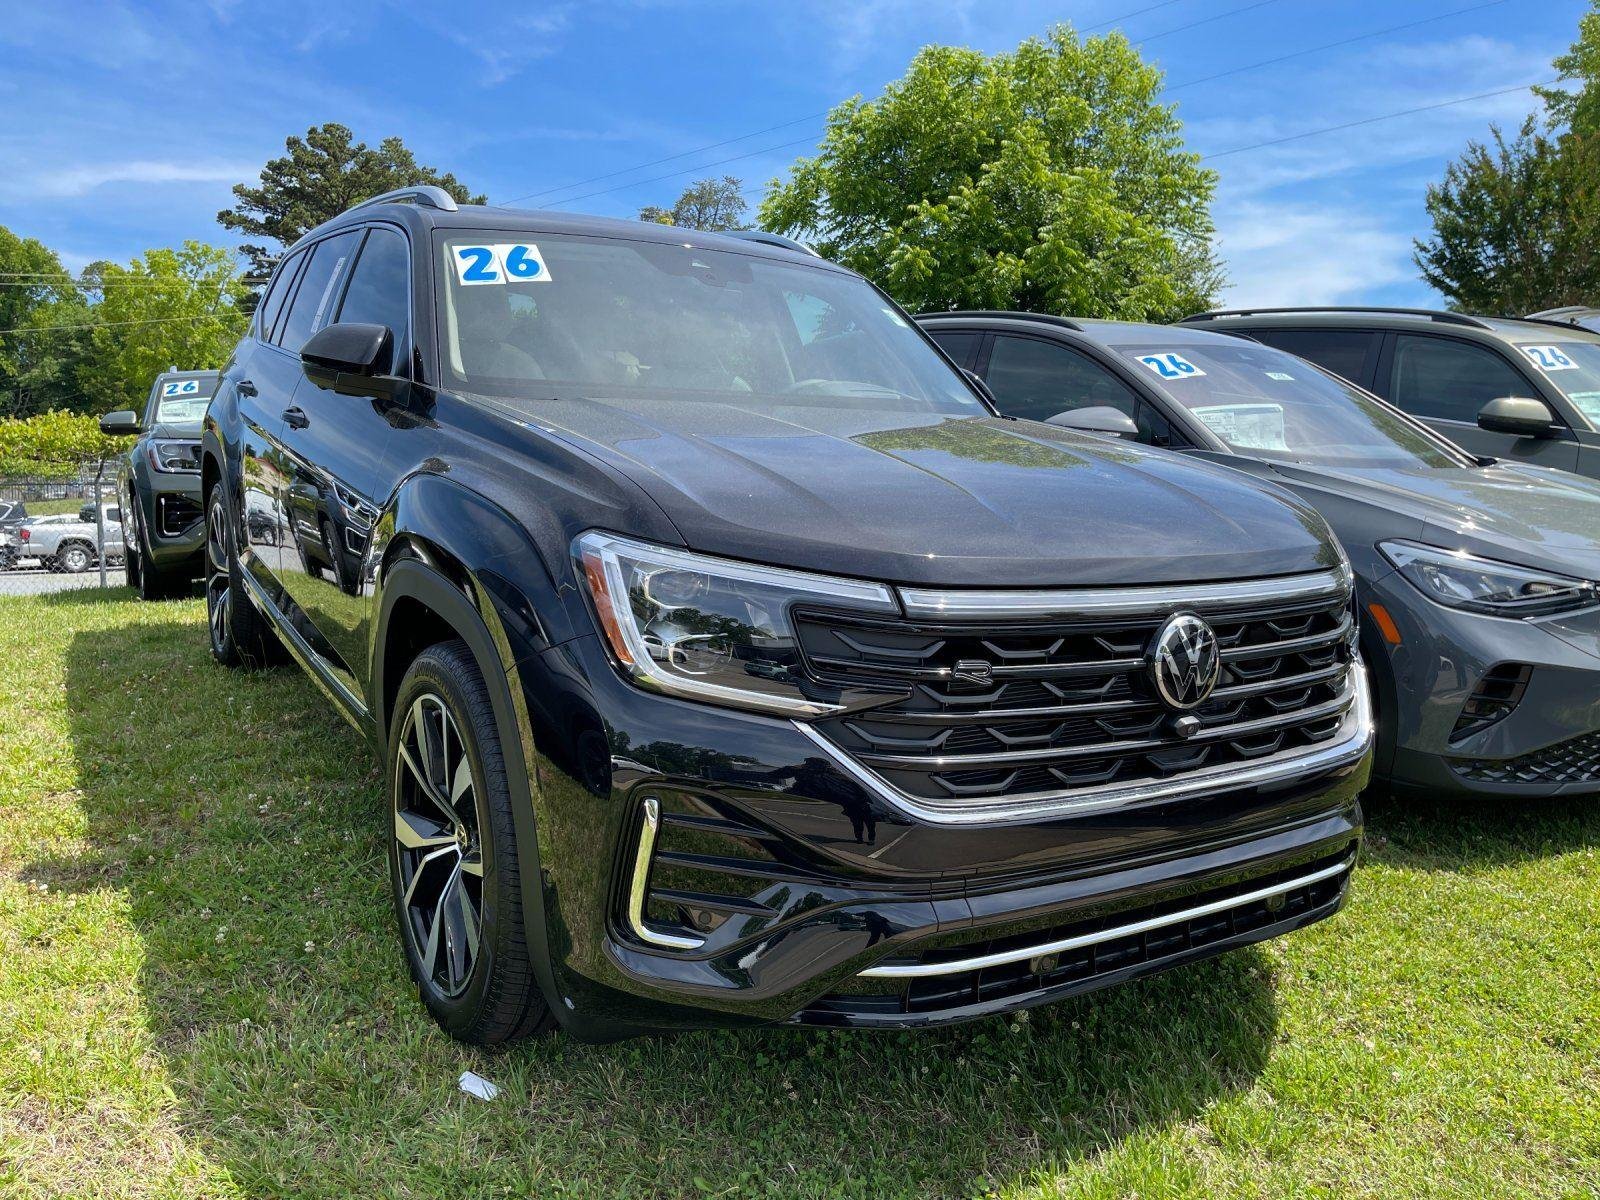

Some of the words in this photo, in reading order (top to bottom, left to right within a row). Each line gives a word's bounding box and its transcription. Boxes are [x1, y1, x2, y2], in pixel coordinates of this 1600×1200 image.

[458, 245, 541, 282] 26
[1142, 354, 1195, 377] 26
[1527, 347, 1571, 367] 26
[166, 381, 197, 395] 26
